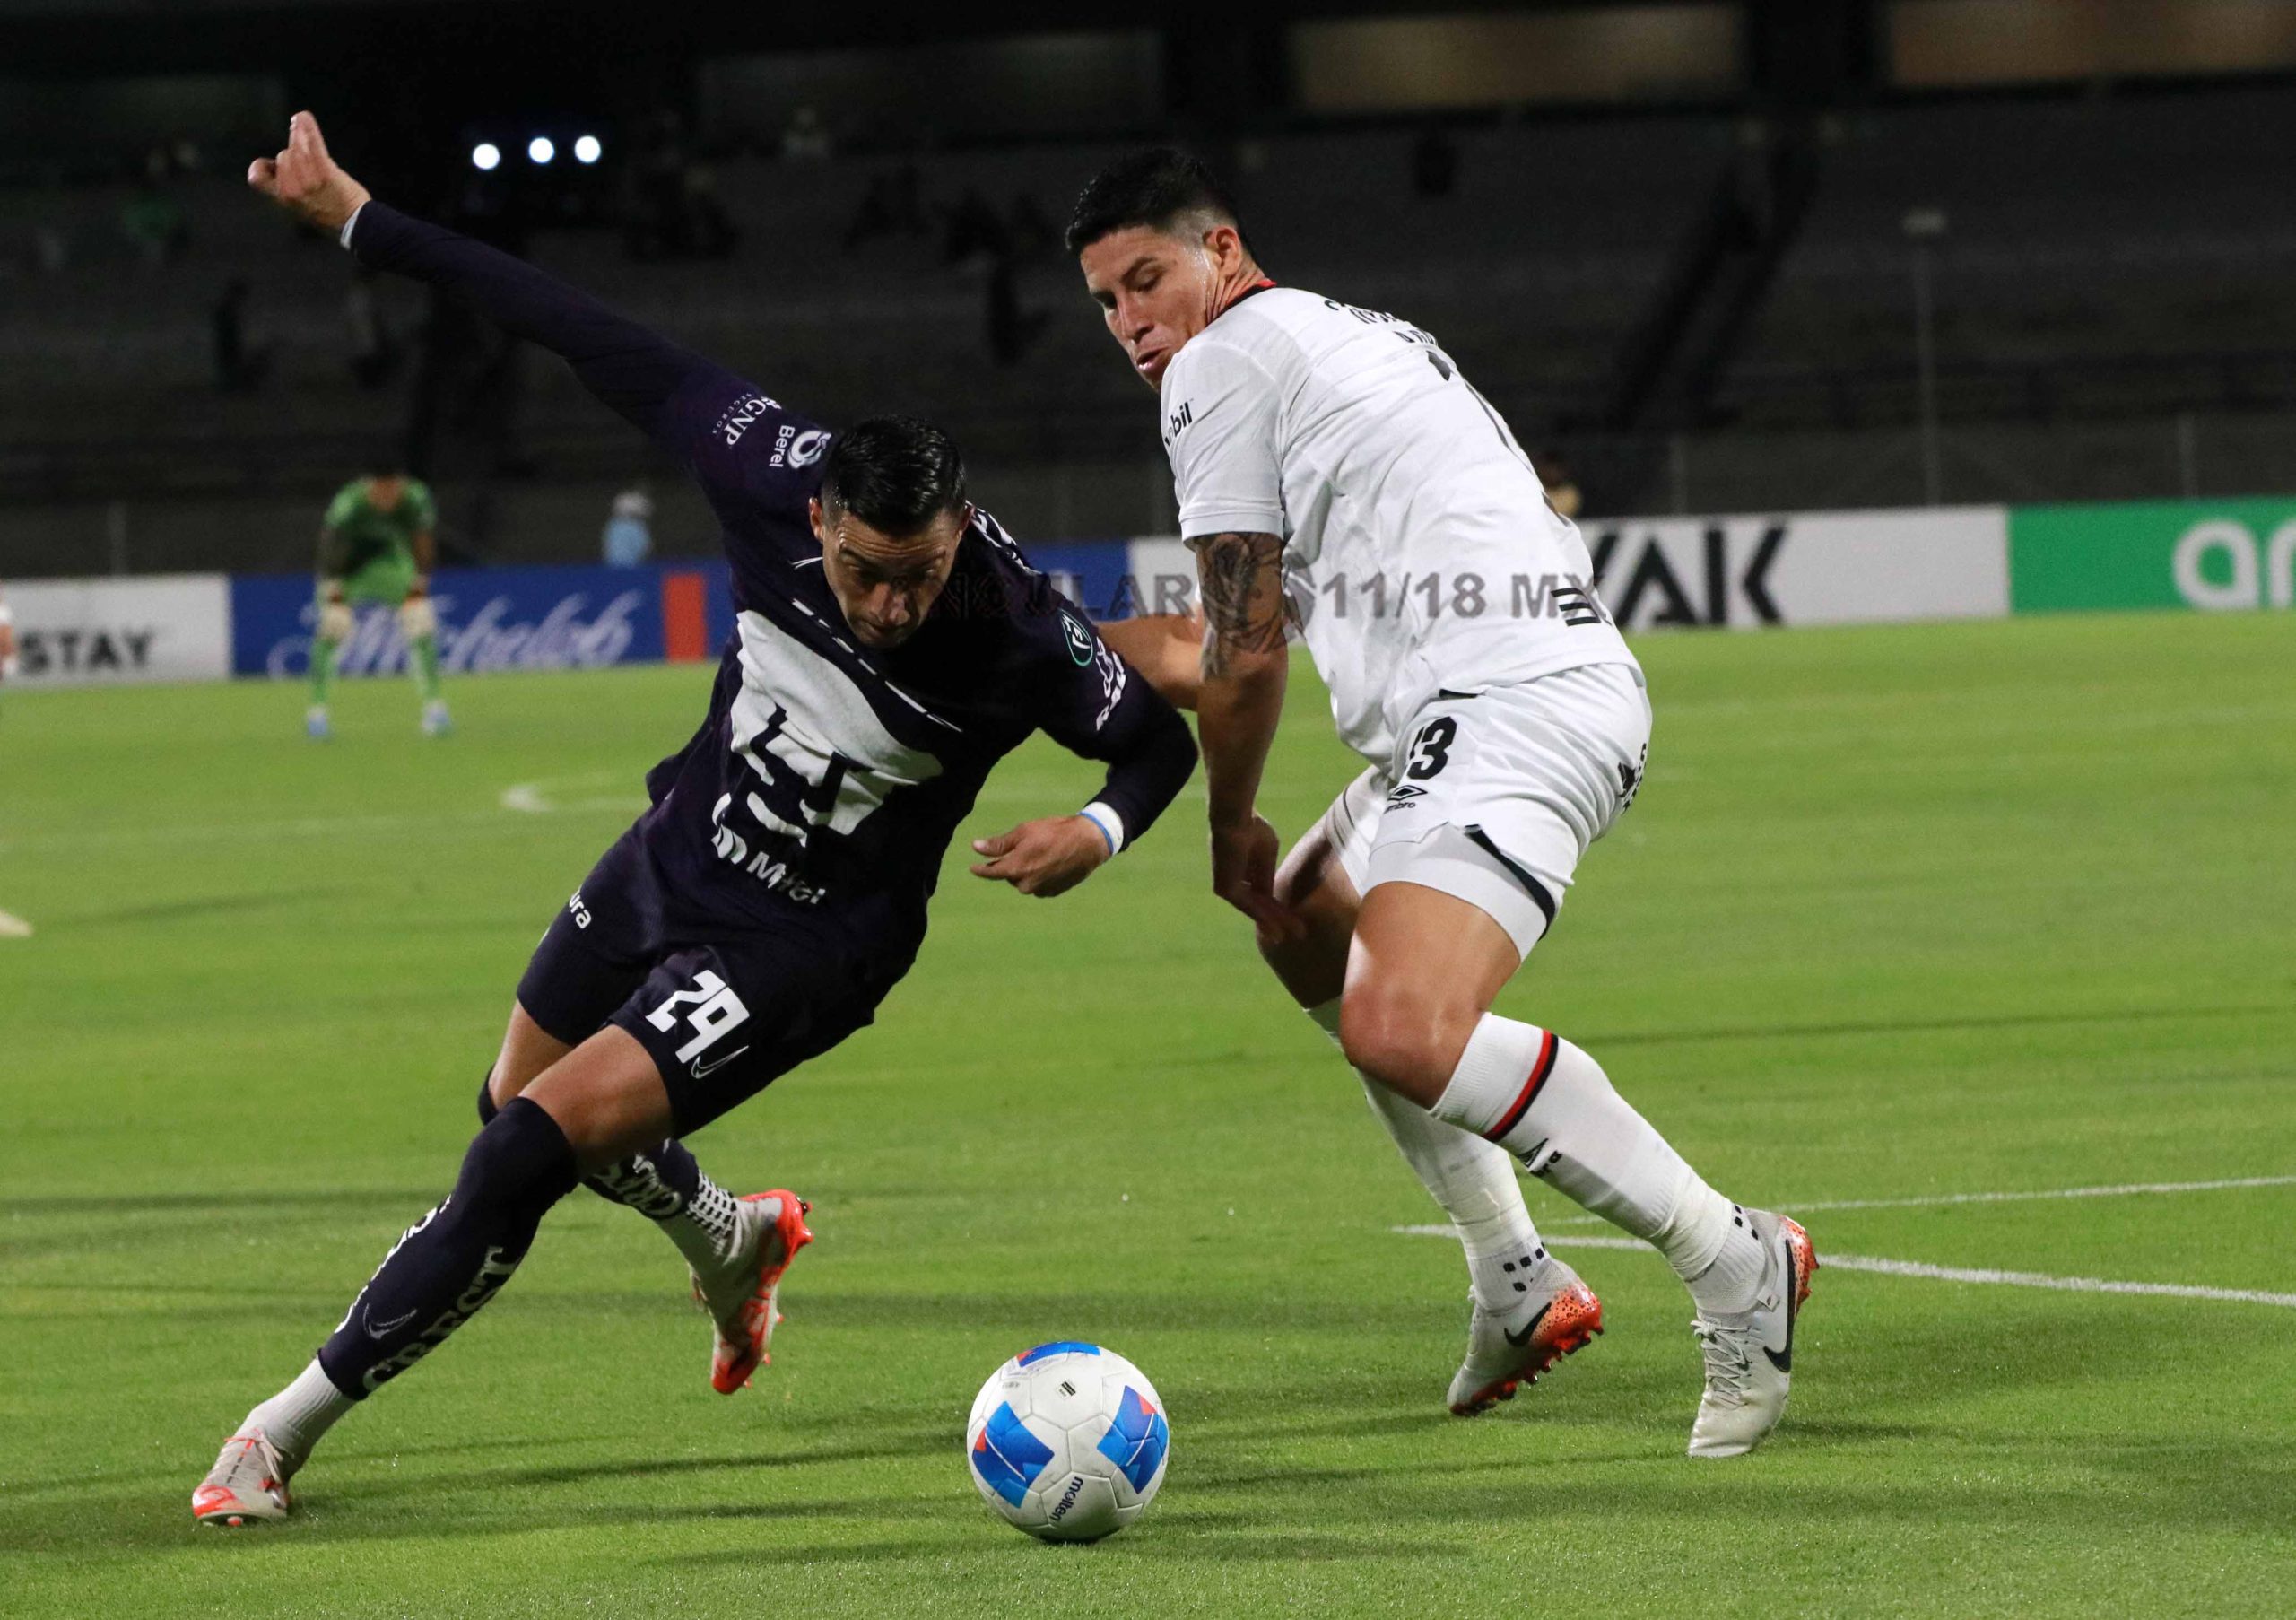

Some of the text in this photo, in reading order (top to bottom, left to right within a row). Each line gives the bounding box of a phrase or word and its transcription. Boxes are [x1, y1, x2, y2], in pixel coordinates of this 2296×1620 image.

[724, 398, 767, 446] GNP
[769, 424, 796, 467] Berel
[1049, 1476, 1083, 1522] molten
